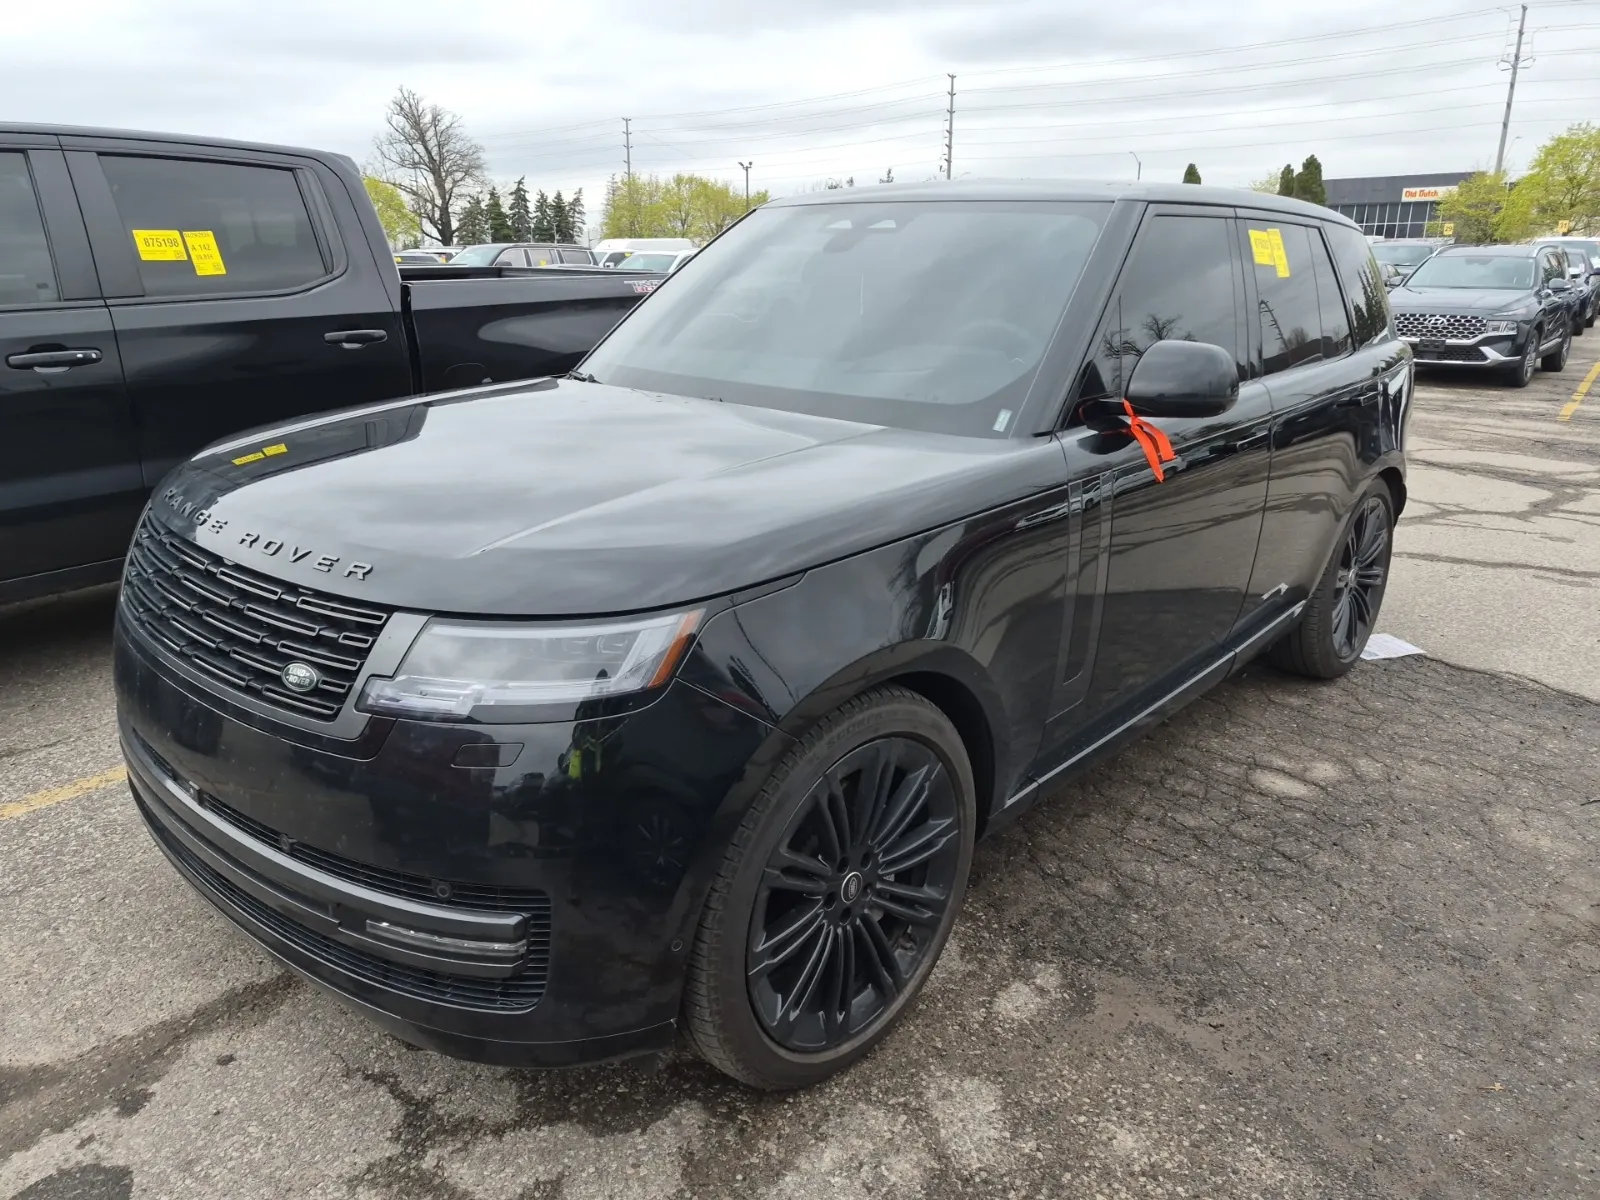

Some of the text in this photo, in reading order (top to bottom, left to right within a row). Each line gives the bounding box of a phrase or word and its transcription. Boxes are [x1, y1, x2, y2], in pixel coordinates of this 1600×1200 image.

[1404, 190, 1417, 198] Old
[143, 237, 180, 248] 875198
[199, 243, 212, 251] 142
[163, 487, 374, 581] RANGE ROVER
[288, 666, 306, 677] LAND
[288, 674, 310, 687] ROVER
